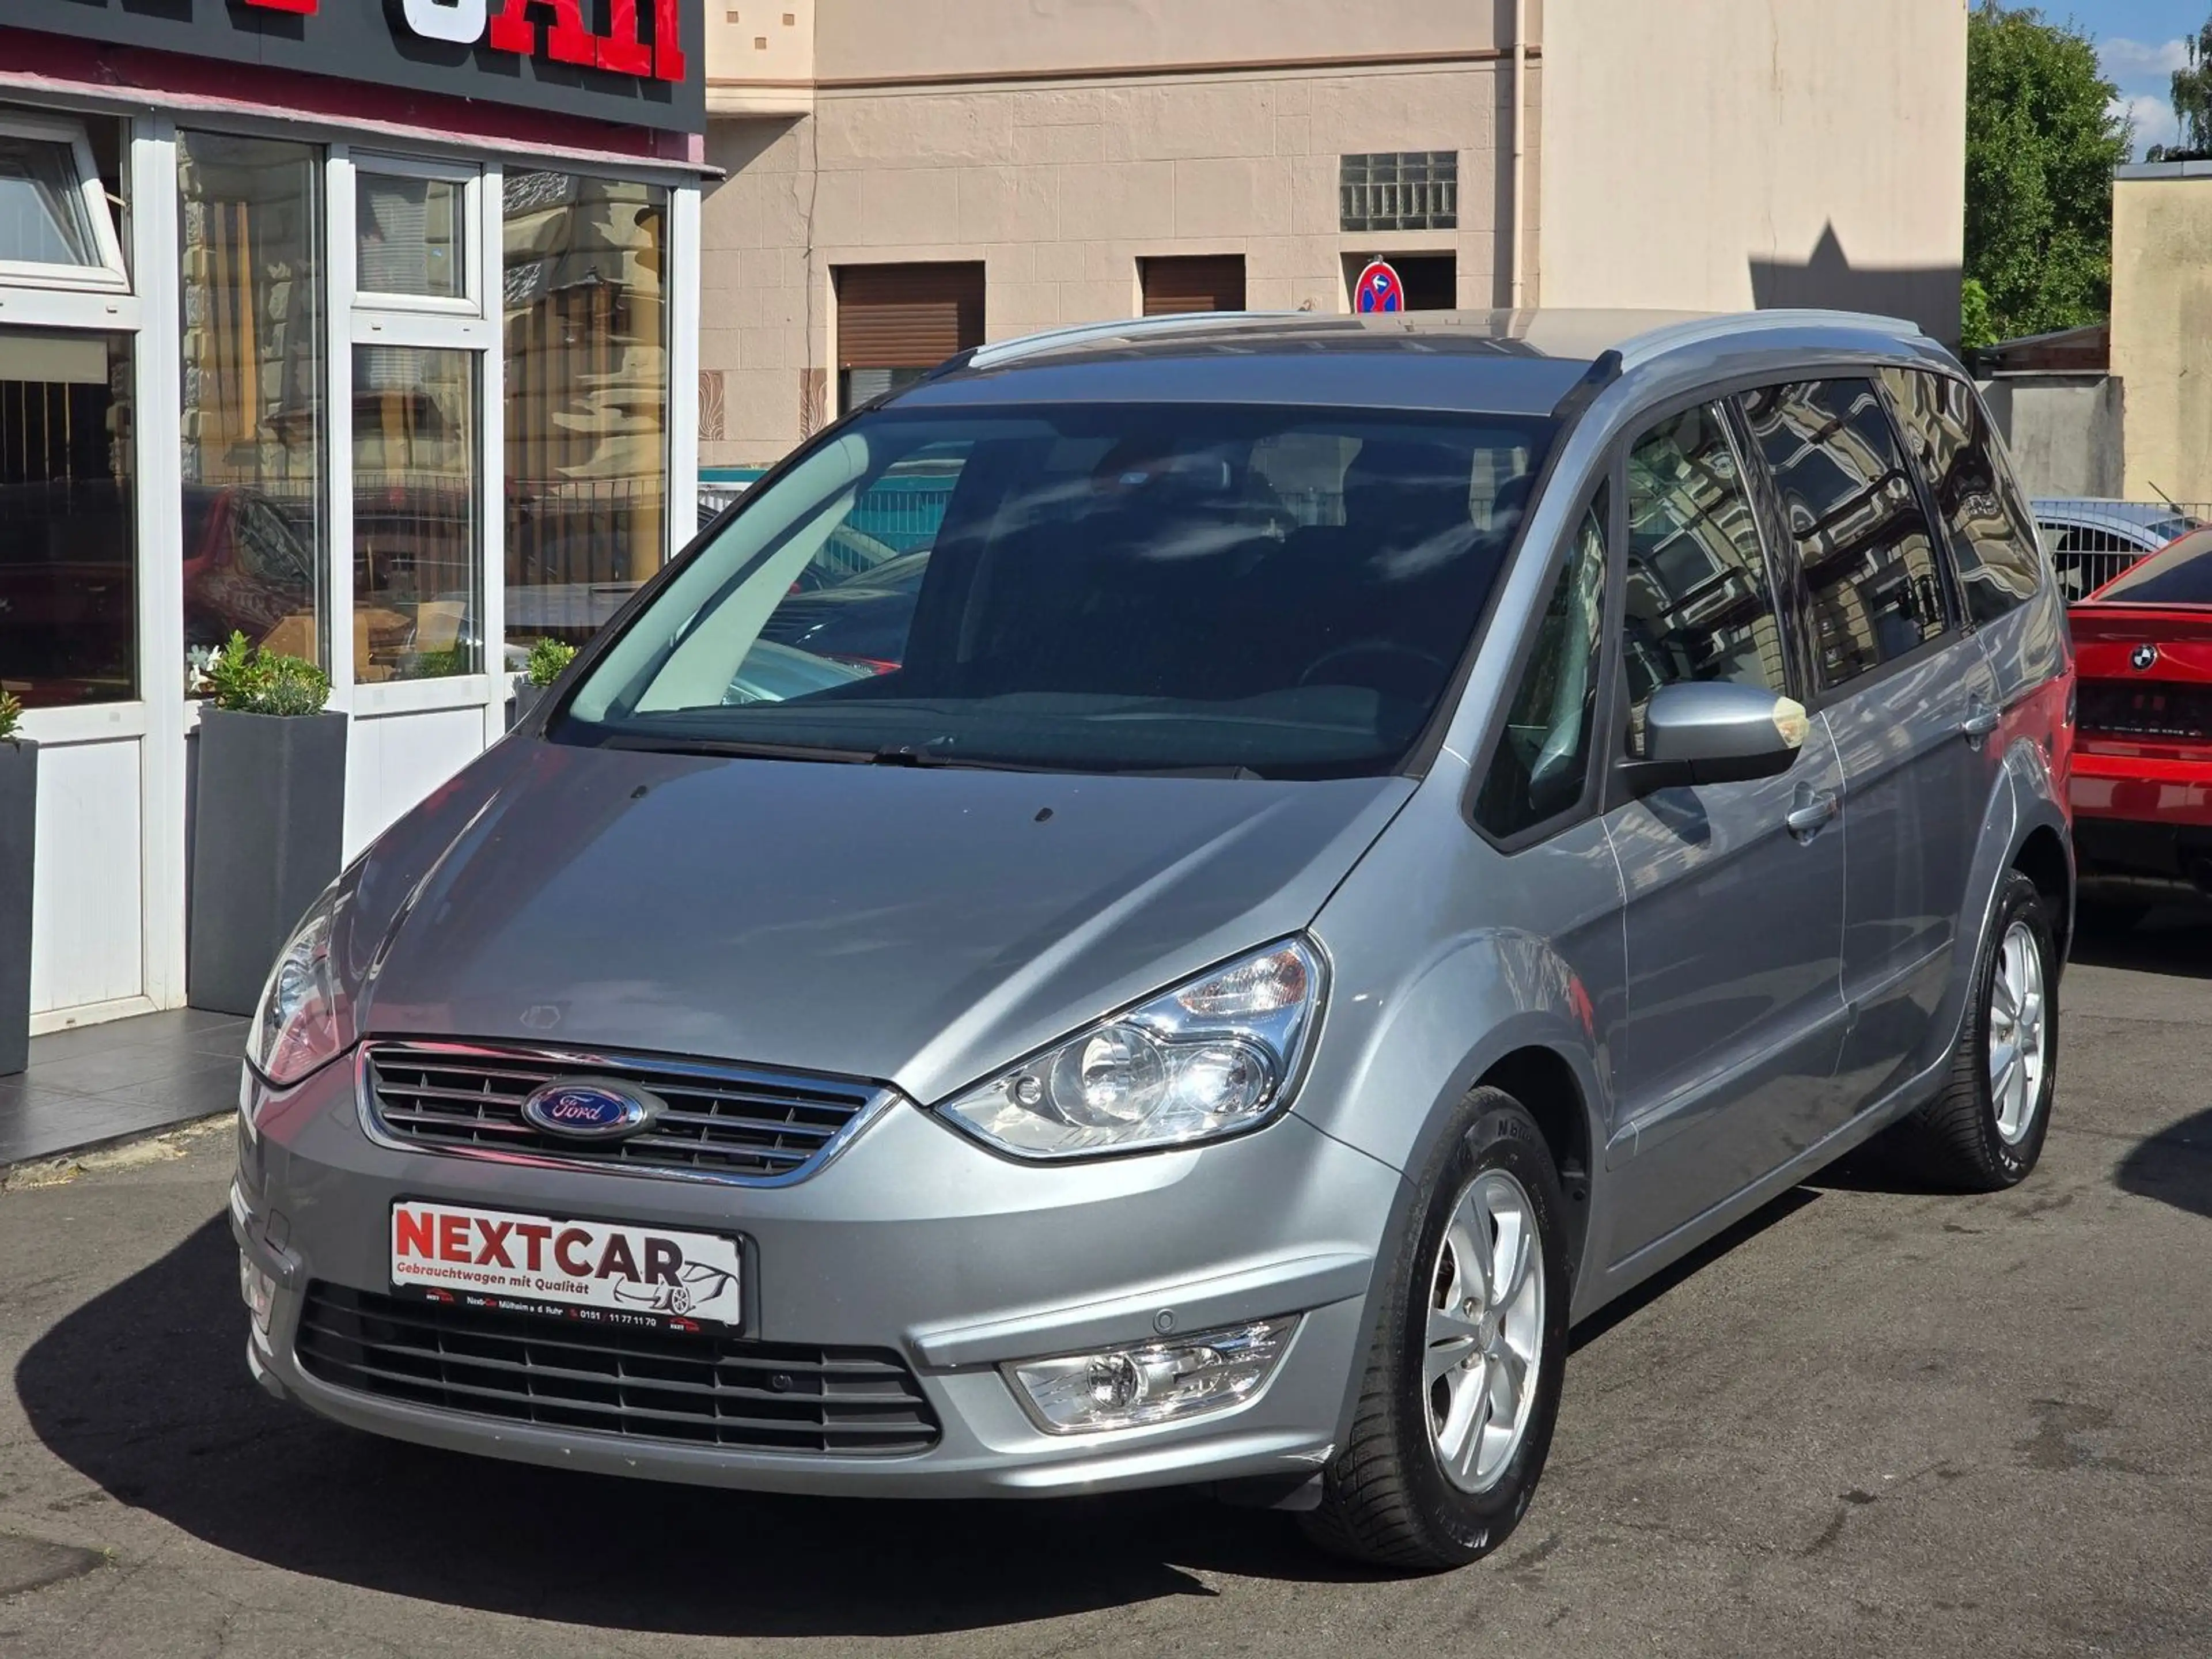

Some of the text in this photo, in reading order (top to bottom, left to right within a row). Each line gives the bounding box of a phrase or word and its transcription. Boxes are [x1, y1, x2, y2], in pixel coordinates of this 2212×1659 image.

[552, 1094, 605, 1120] Ford
[395, 1209, 684, 1288] NEXTCAR
[396, 1262, 590, 1295] Gebrauchtwagen mit Qualität
[546, 1305, 564, 1316] Ruhr
